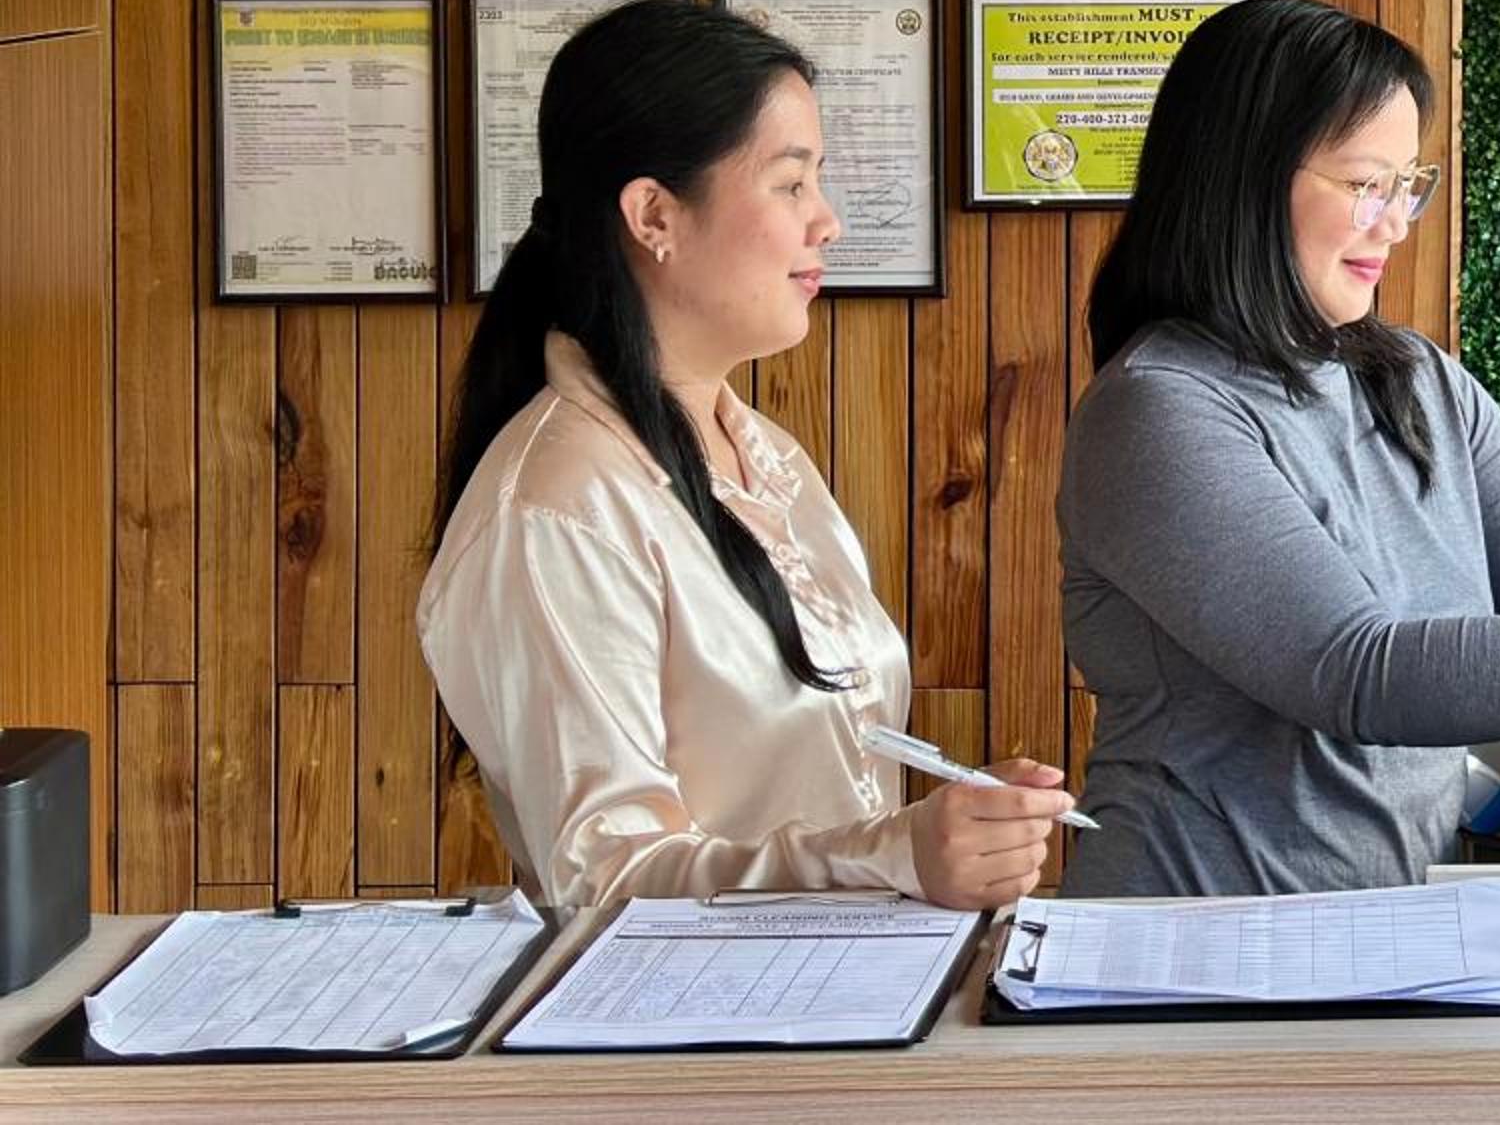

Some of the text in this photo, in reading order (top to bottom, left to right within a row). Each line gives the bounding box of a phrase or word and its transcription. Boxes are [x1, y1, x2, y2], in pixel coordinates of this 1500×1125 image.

[1007, 11, 1037, 24] This
[1038, 11, 1134, 24] establishment
[1138, 8, 1195, 22] MUST
[1028, 29, 1190, 47] RECEIPT/INVOI
[991, 52, 1011, 63] for
[1013, 52, 1045, 63] each
[1048, 52, 1094, 63] service
